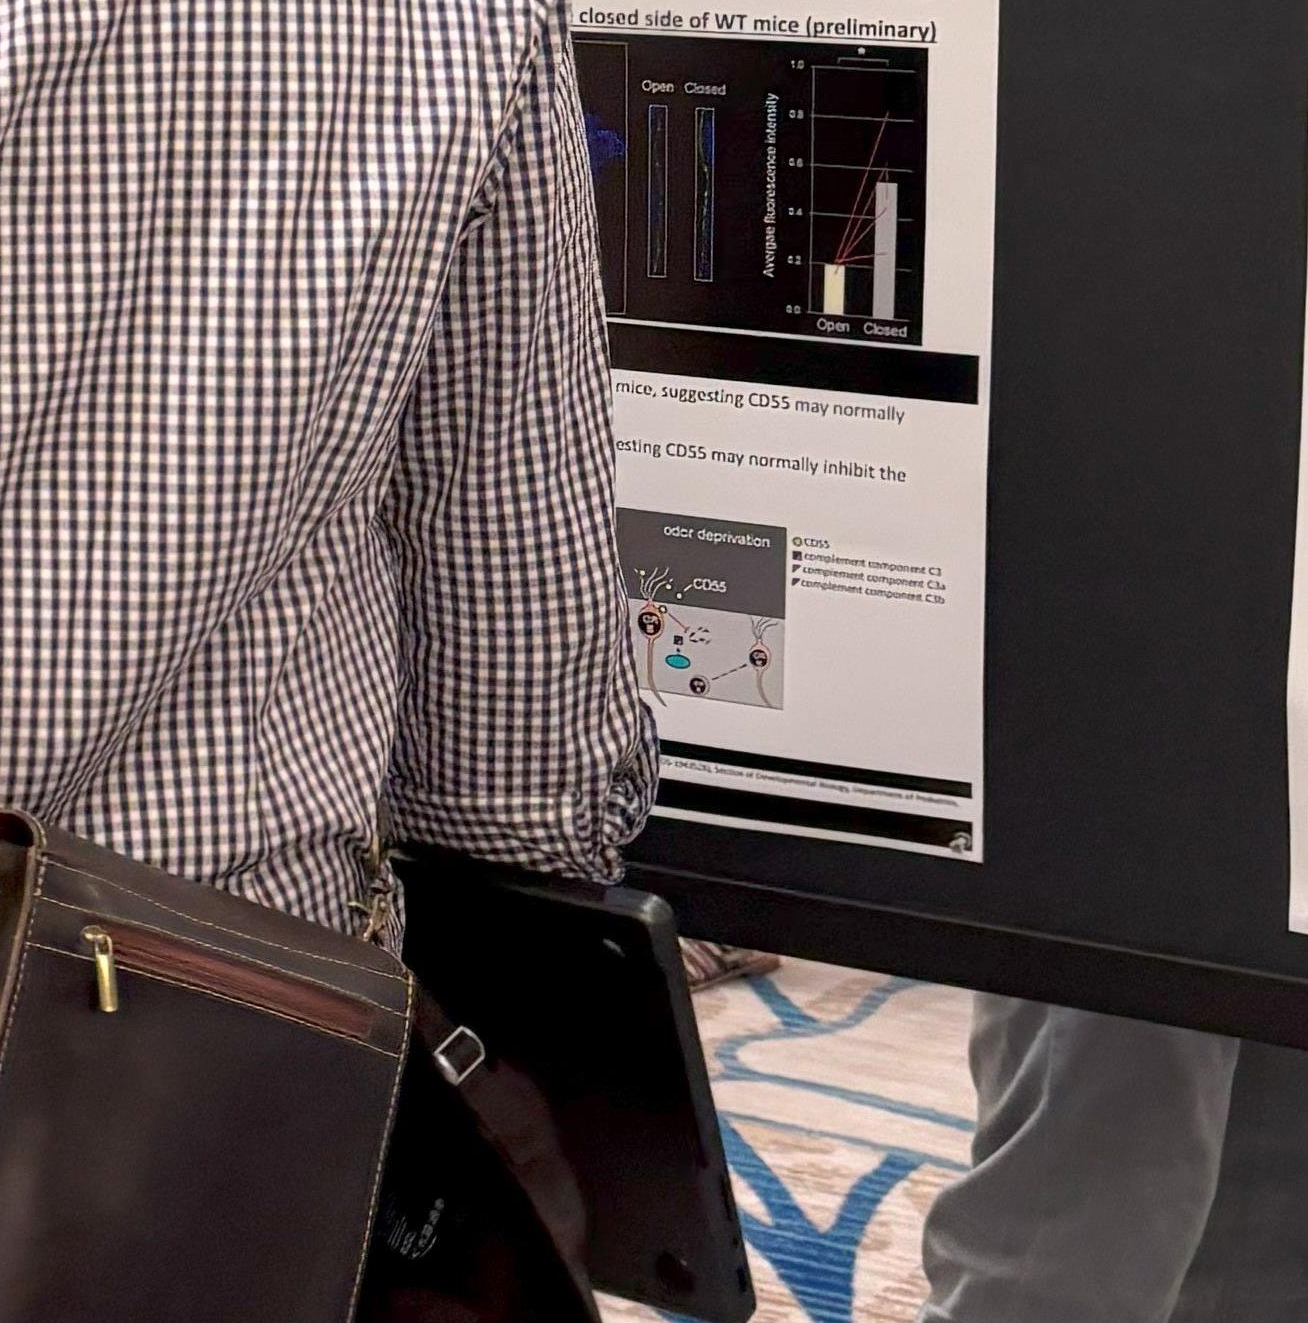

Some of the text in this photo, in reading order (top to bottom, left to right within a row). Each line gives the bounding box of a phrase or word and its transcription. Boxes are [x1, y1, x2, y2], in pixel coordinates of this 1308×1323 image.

[578, 7, 937, 44] closed side of WT mice (preliminary)
[615, 379, 905, 425] mice, suggesting CD55 may normally
[664, 441, 907, 483] CD55 may normally inhibit the
[662, 524, 771, 548] odor deprivation
